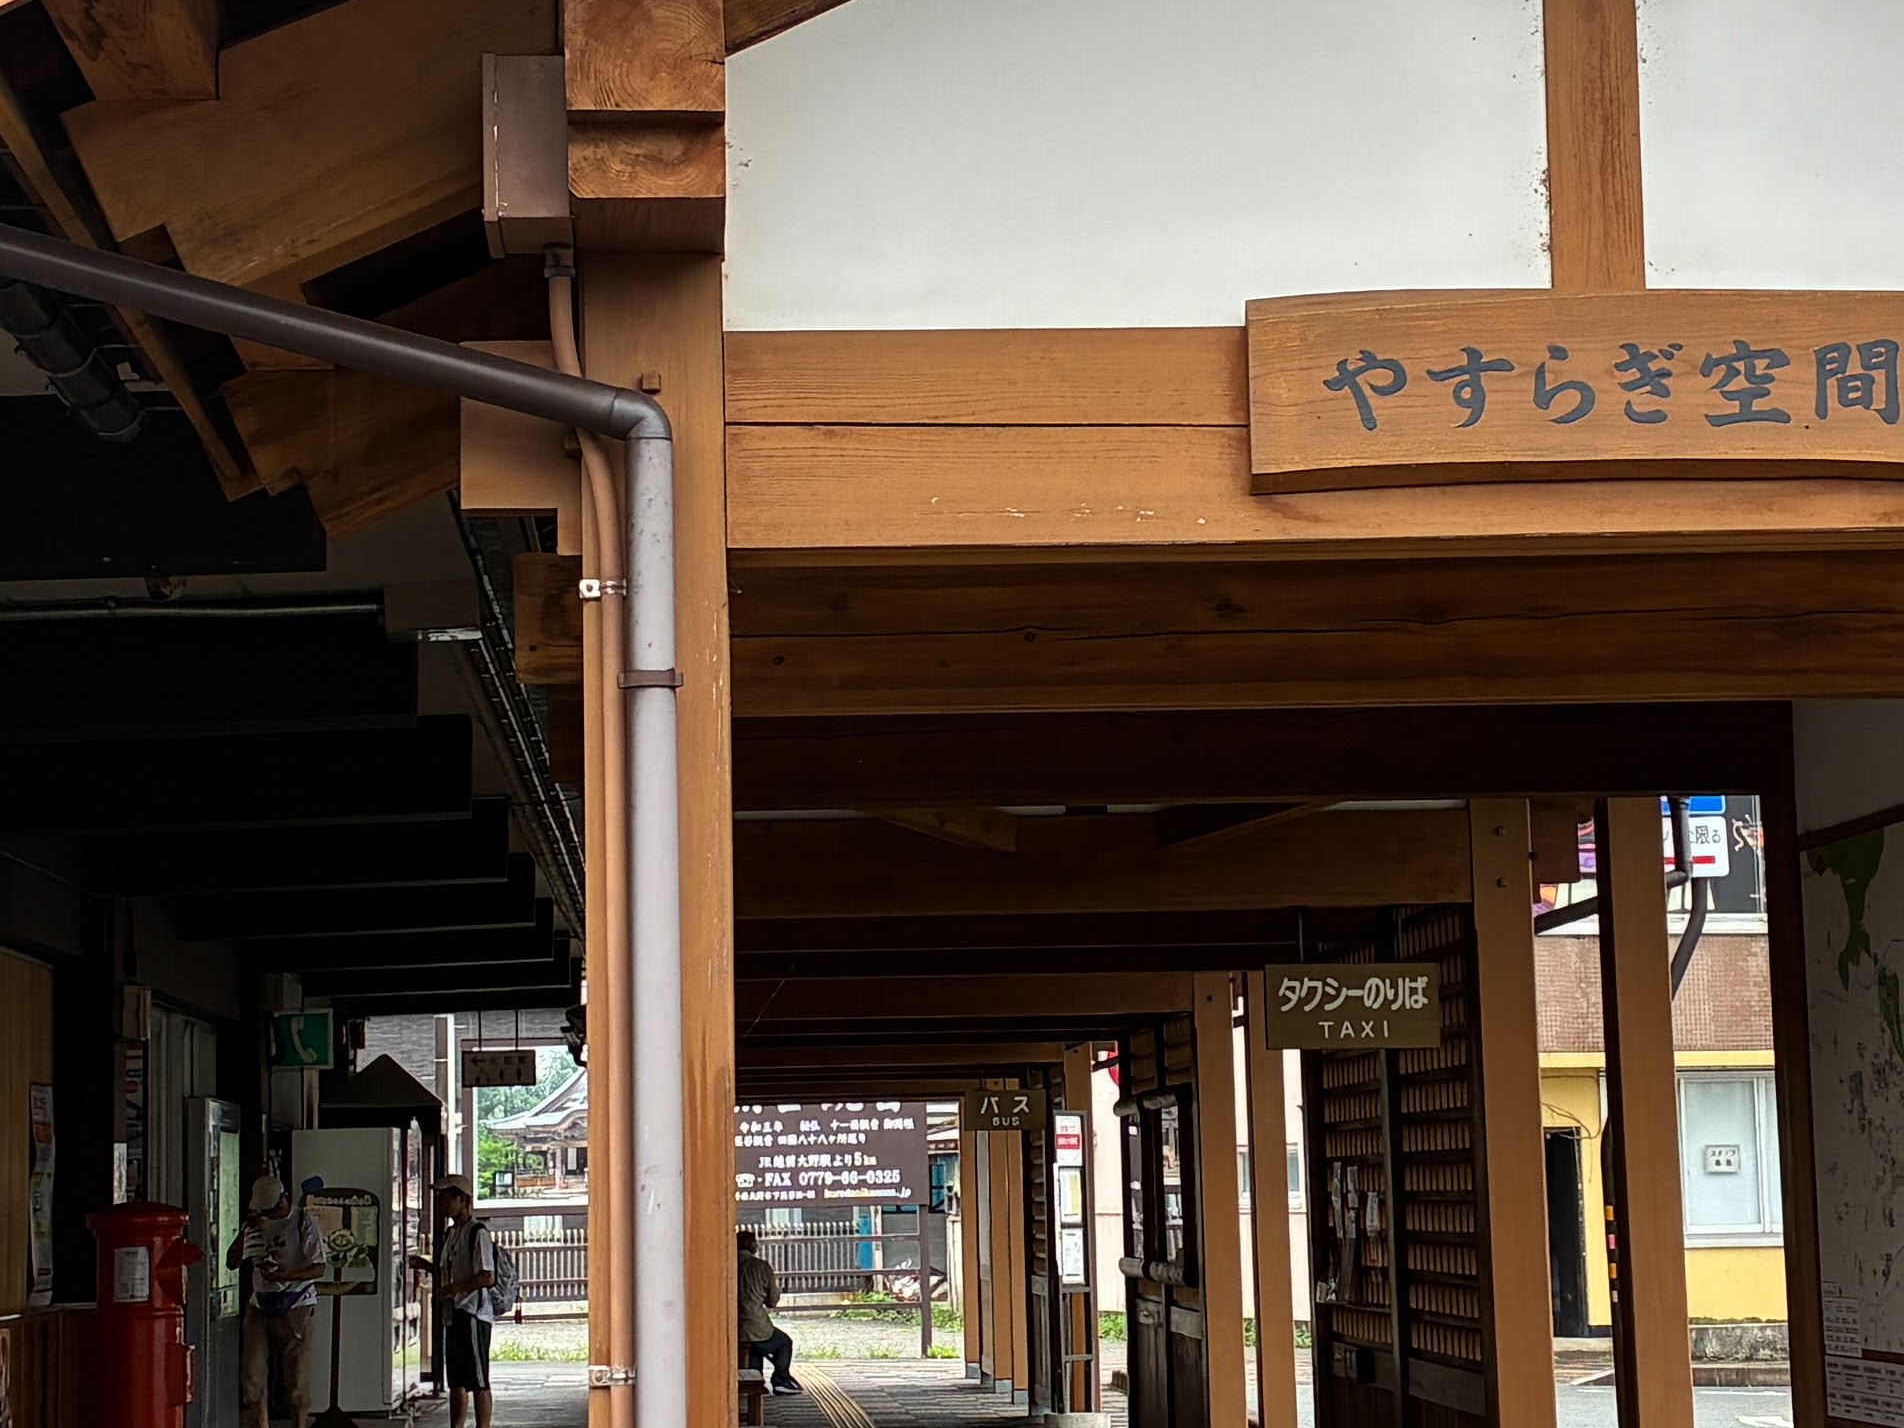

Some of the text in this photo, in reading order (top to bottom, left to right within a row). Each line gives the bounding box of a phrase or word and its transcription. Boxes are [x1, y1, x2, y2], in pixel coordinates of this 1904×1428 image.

[1322, 338, 1901, 431] やすらぎ空間
[1278, 976, 1429, 1012] タクシーのりば
[1318, 1019, 1389, 1039] TAXI
[980, 1095, 1030, 1114] バス
[992, 1116, 1020, 1127] BUS
